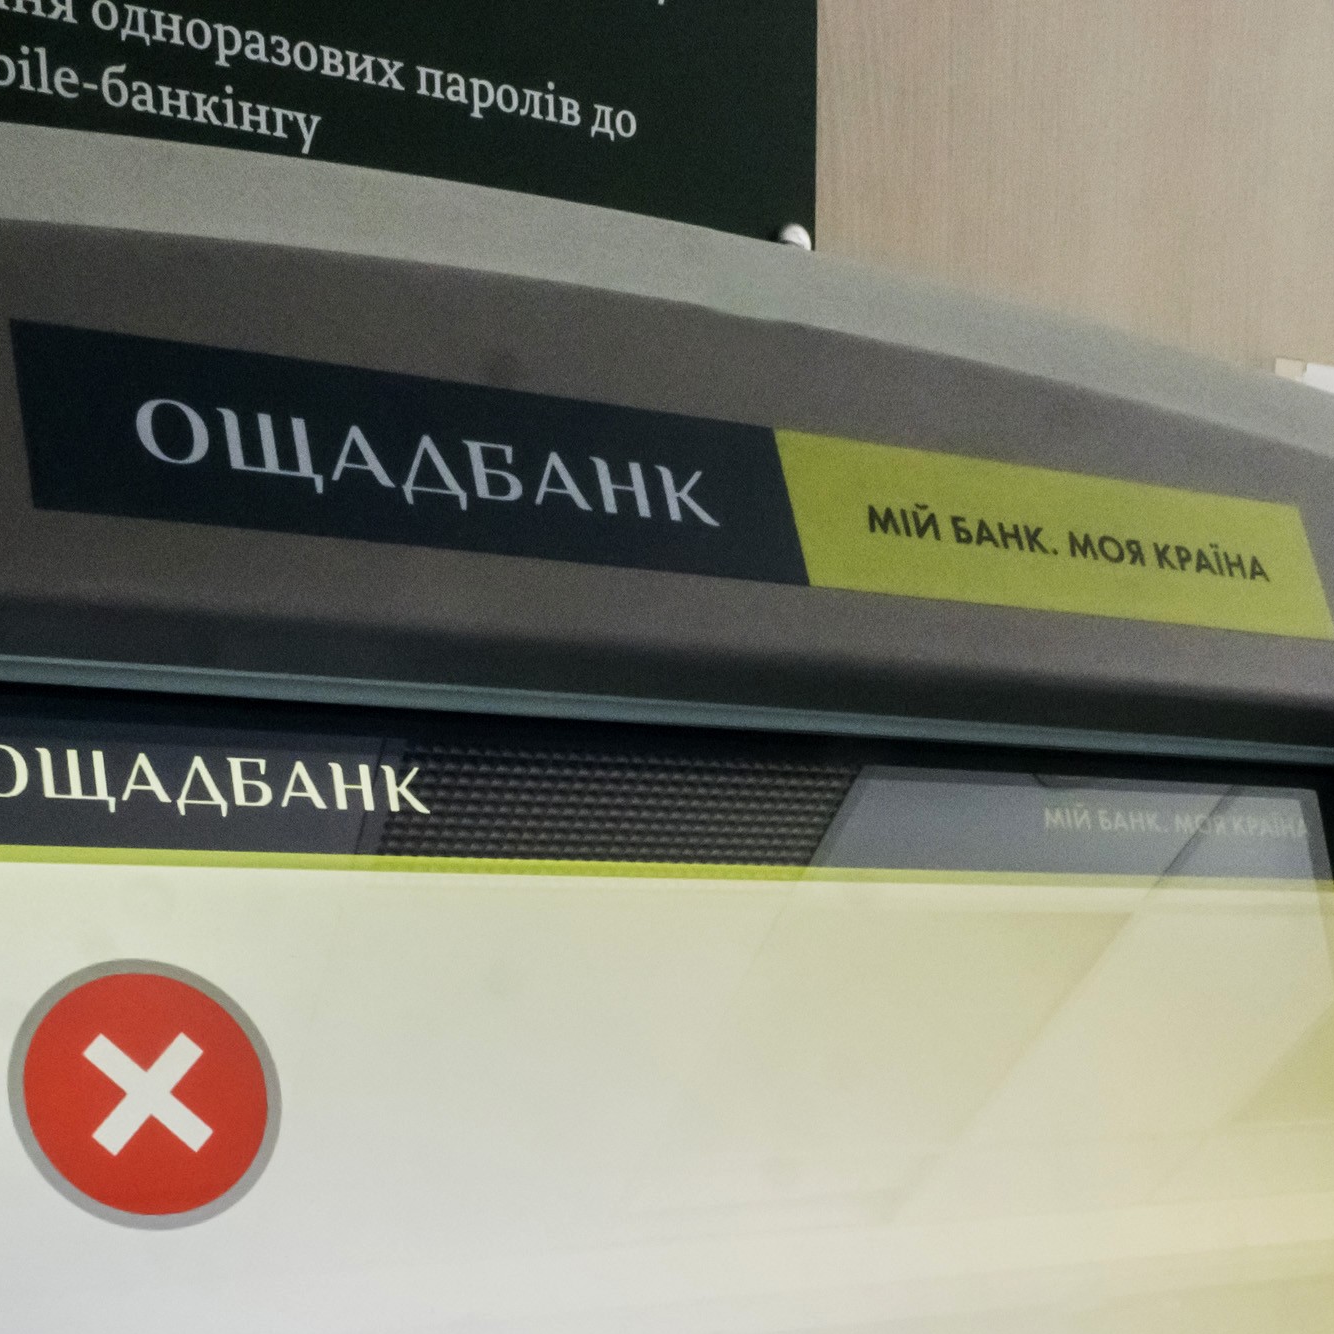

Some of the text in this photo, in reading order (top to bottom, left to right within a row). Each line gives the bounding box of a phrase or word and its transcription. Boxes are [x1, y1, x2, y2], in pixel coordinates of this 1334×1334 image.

[92, 0, 637, 141] одноразових паролів до
[135, 398, 721, 528] ОЩАДБАНК
[868, 502, 1271, 582] МІЙ БАНК. МОЯ КРАЇНА
